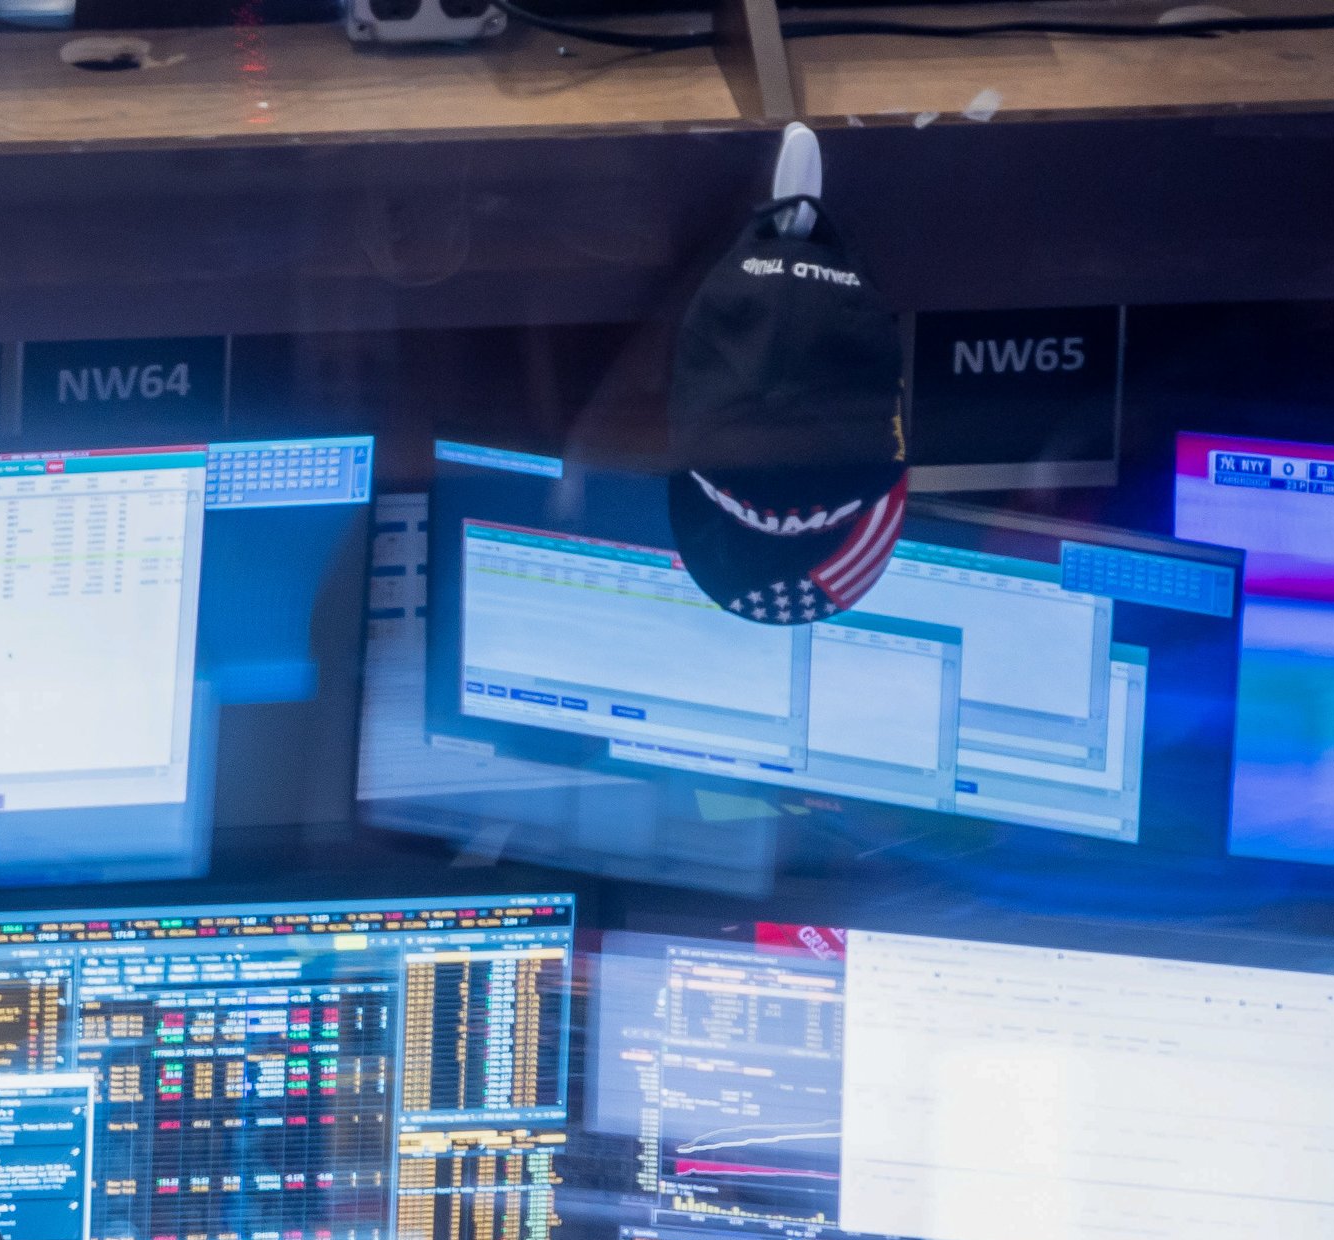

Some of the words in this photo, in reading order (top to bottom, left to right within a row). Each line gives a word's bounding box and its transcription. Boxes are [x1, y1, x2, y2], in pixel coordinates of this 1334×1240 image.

[954, 336, 1085, 375] NW65
[58, 362, 191, 404] NW64
[1241, 457, 1266, 472] NYY
